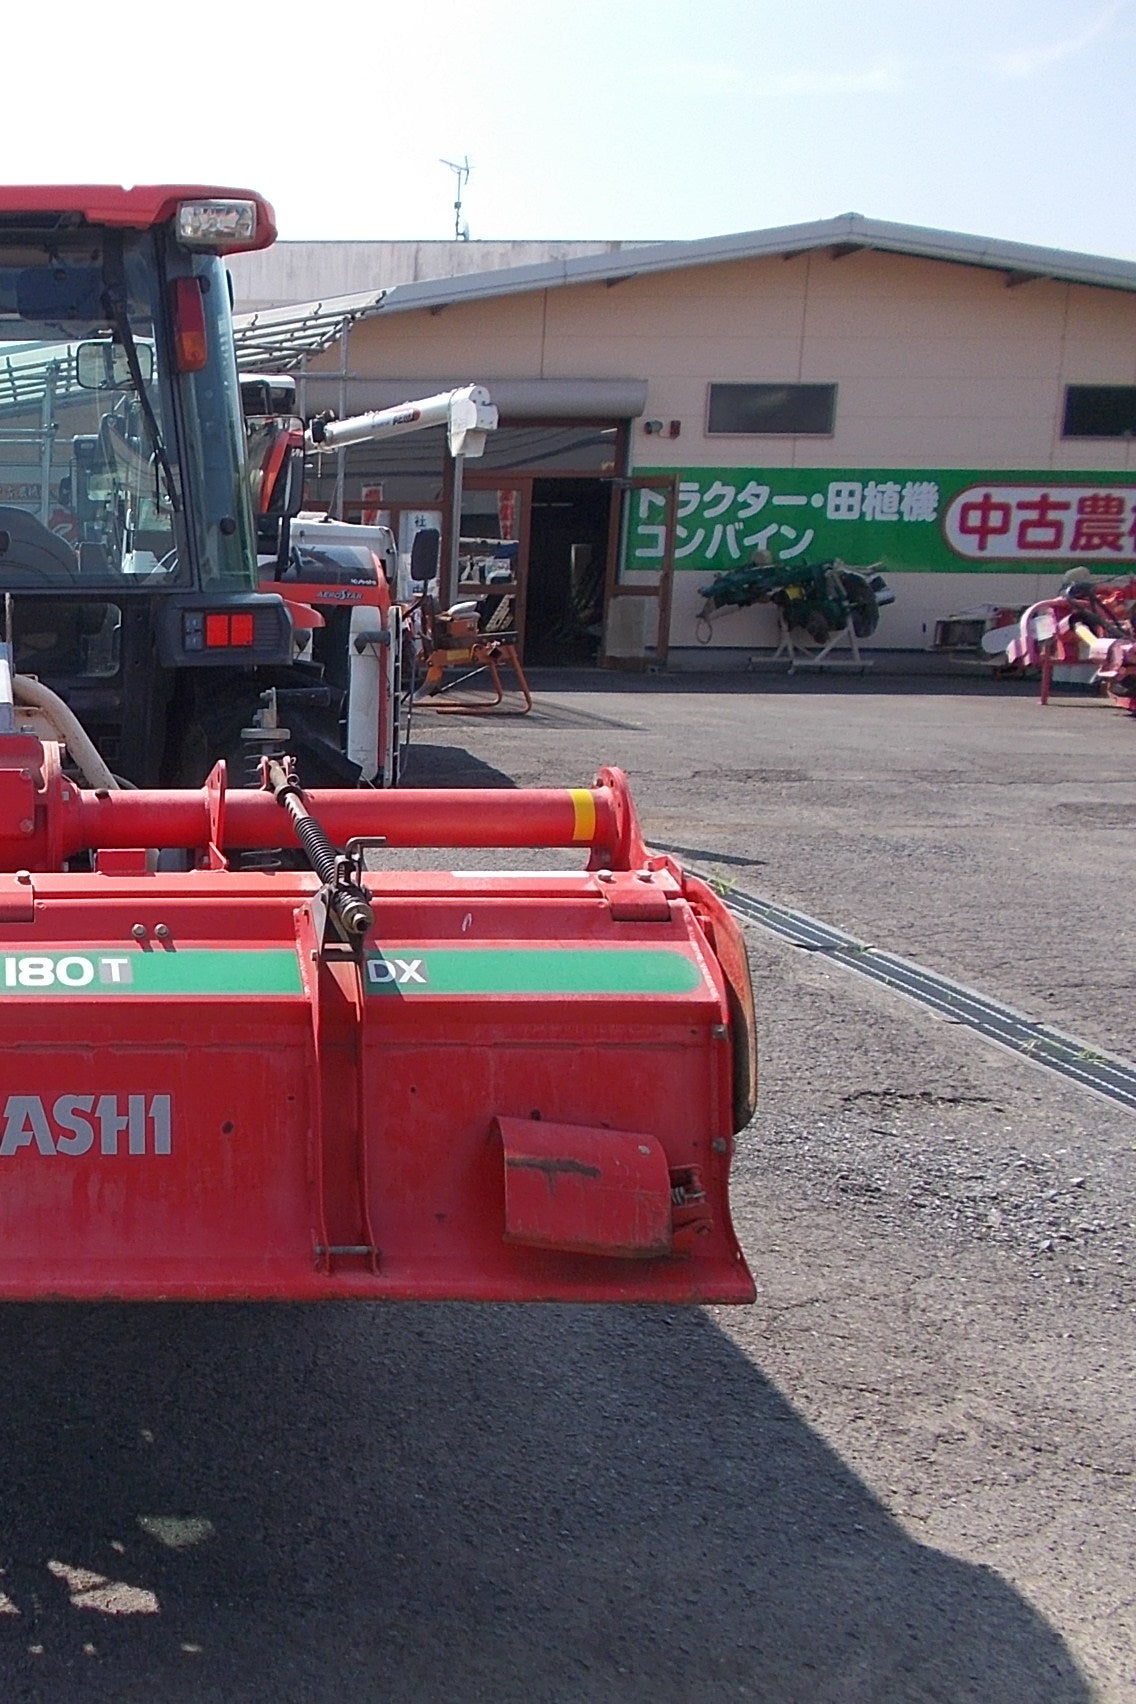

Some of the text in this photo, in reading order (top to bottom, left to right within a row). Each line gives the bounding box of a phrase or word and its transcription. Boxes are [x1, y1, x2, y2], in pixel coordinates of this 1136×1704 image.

[638, 481, 940, 522] トラクター・田植機
[635, 521, 814, 559] コンバイン
[959, 493, 1136, 551] 中古農
[366, 959, 428, 983] DX
